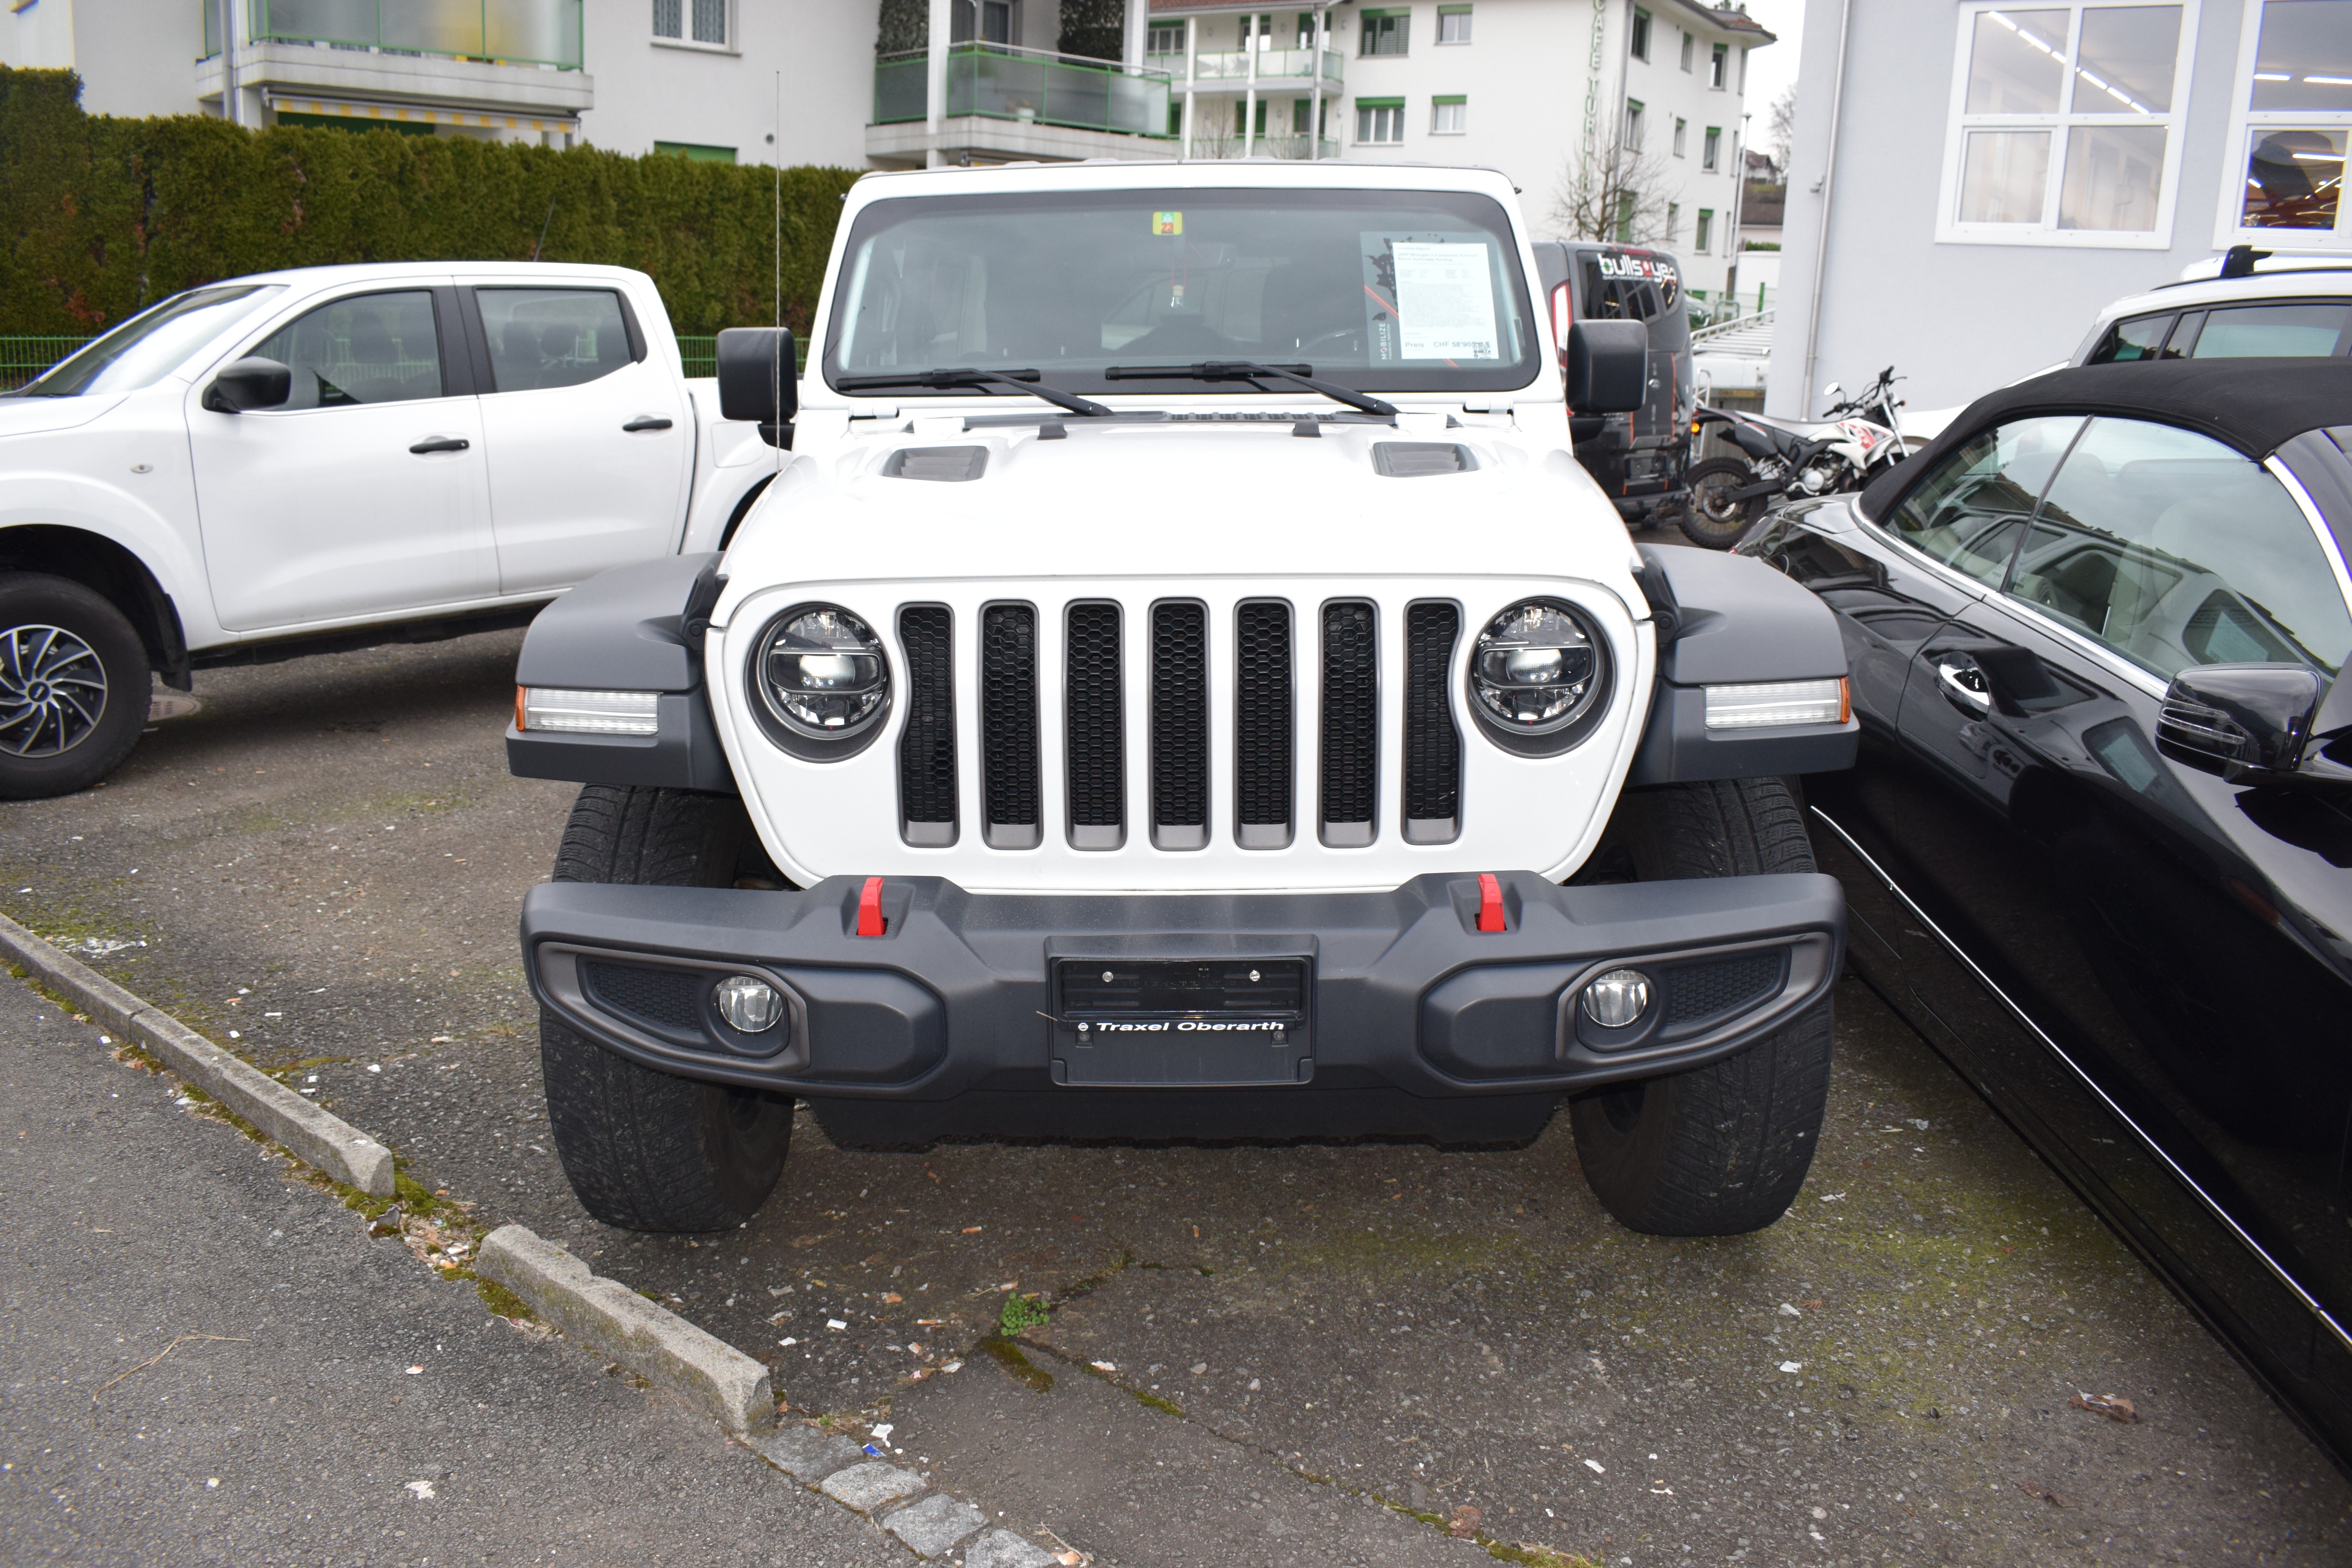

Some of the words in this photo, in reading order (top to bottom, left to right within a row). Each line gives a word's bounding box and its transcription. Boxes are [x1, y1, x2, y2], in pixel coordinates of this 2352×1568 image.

[1161, 222, 1174, 233] 23
[1379, 323, 1388, 360] MOBILIZE
[1096, 1022, 1169, 1031] Traxel
[1177, 1022, 1285, 1031] Oberarth
